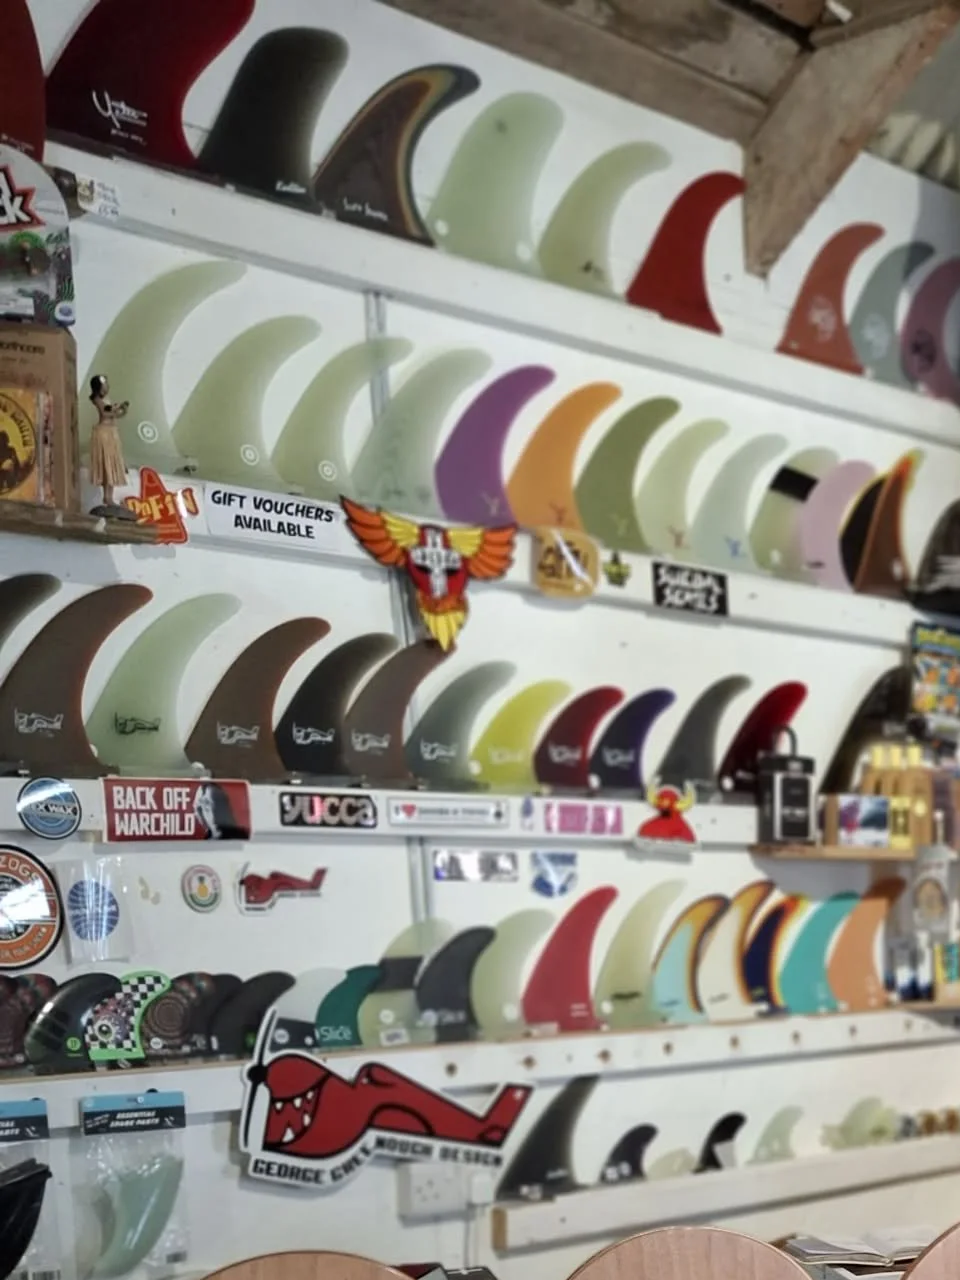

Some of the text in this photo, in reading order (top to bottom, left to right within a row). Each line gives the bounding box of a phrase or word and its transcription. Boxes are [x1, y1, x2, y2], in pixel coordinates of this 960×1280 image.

[211, 490, 335, 523] GIFT VOUCHERS
[234, 514, 315, 539] AVAILABLE
[112, 785, 191, 810] BACK OFF
[115, 812, 195, 836] WARCHILD
[252, 1157, 325, 1185] GEORGE
[439, 1147, 503, 1168] DESIGN
